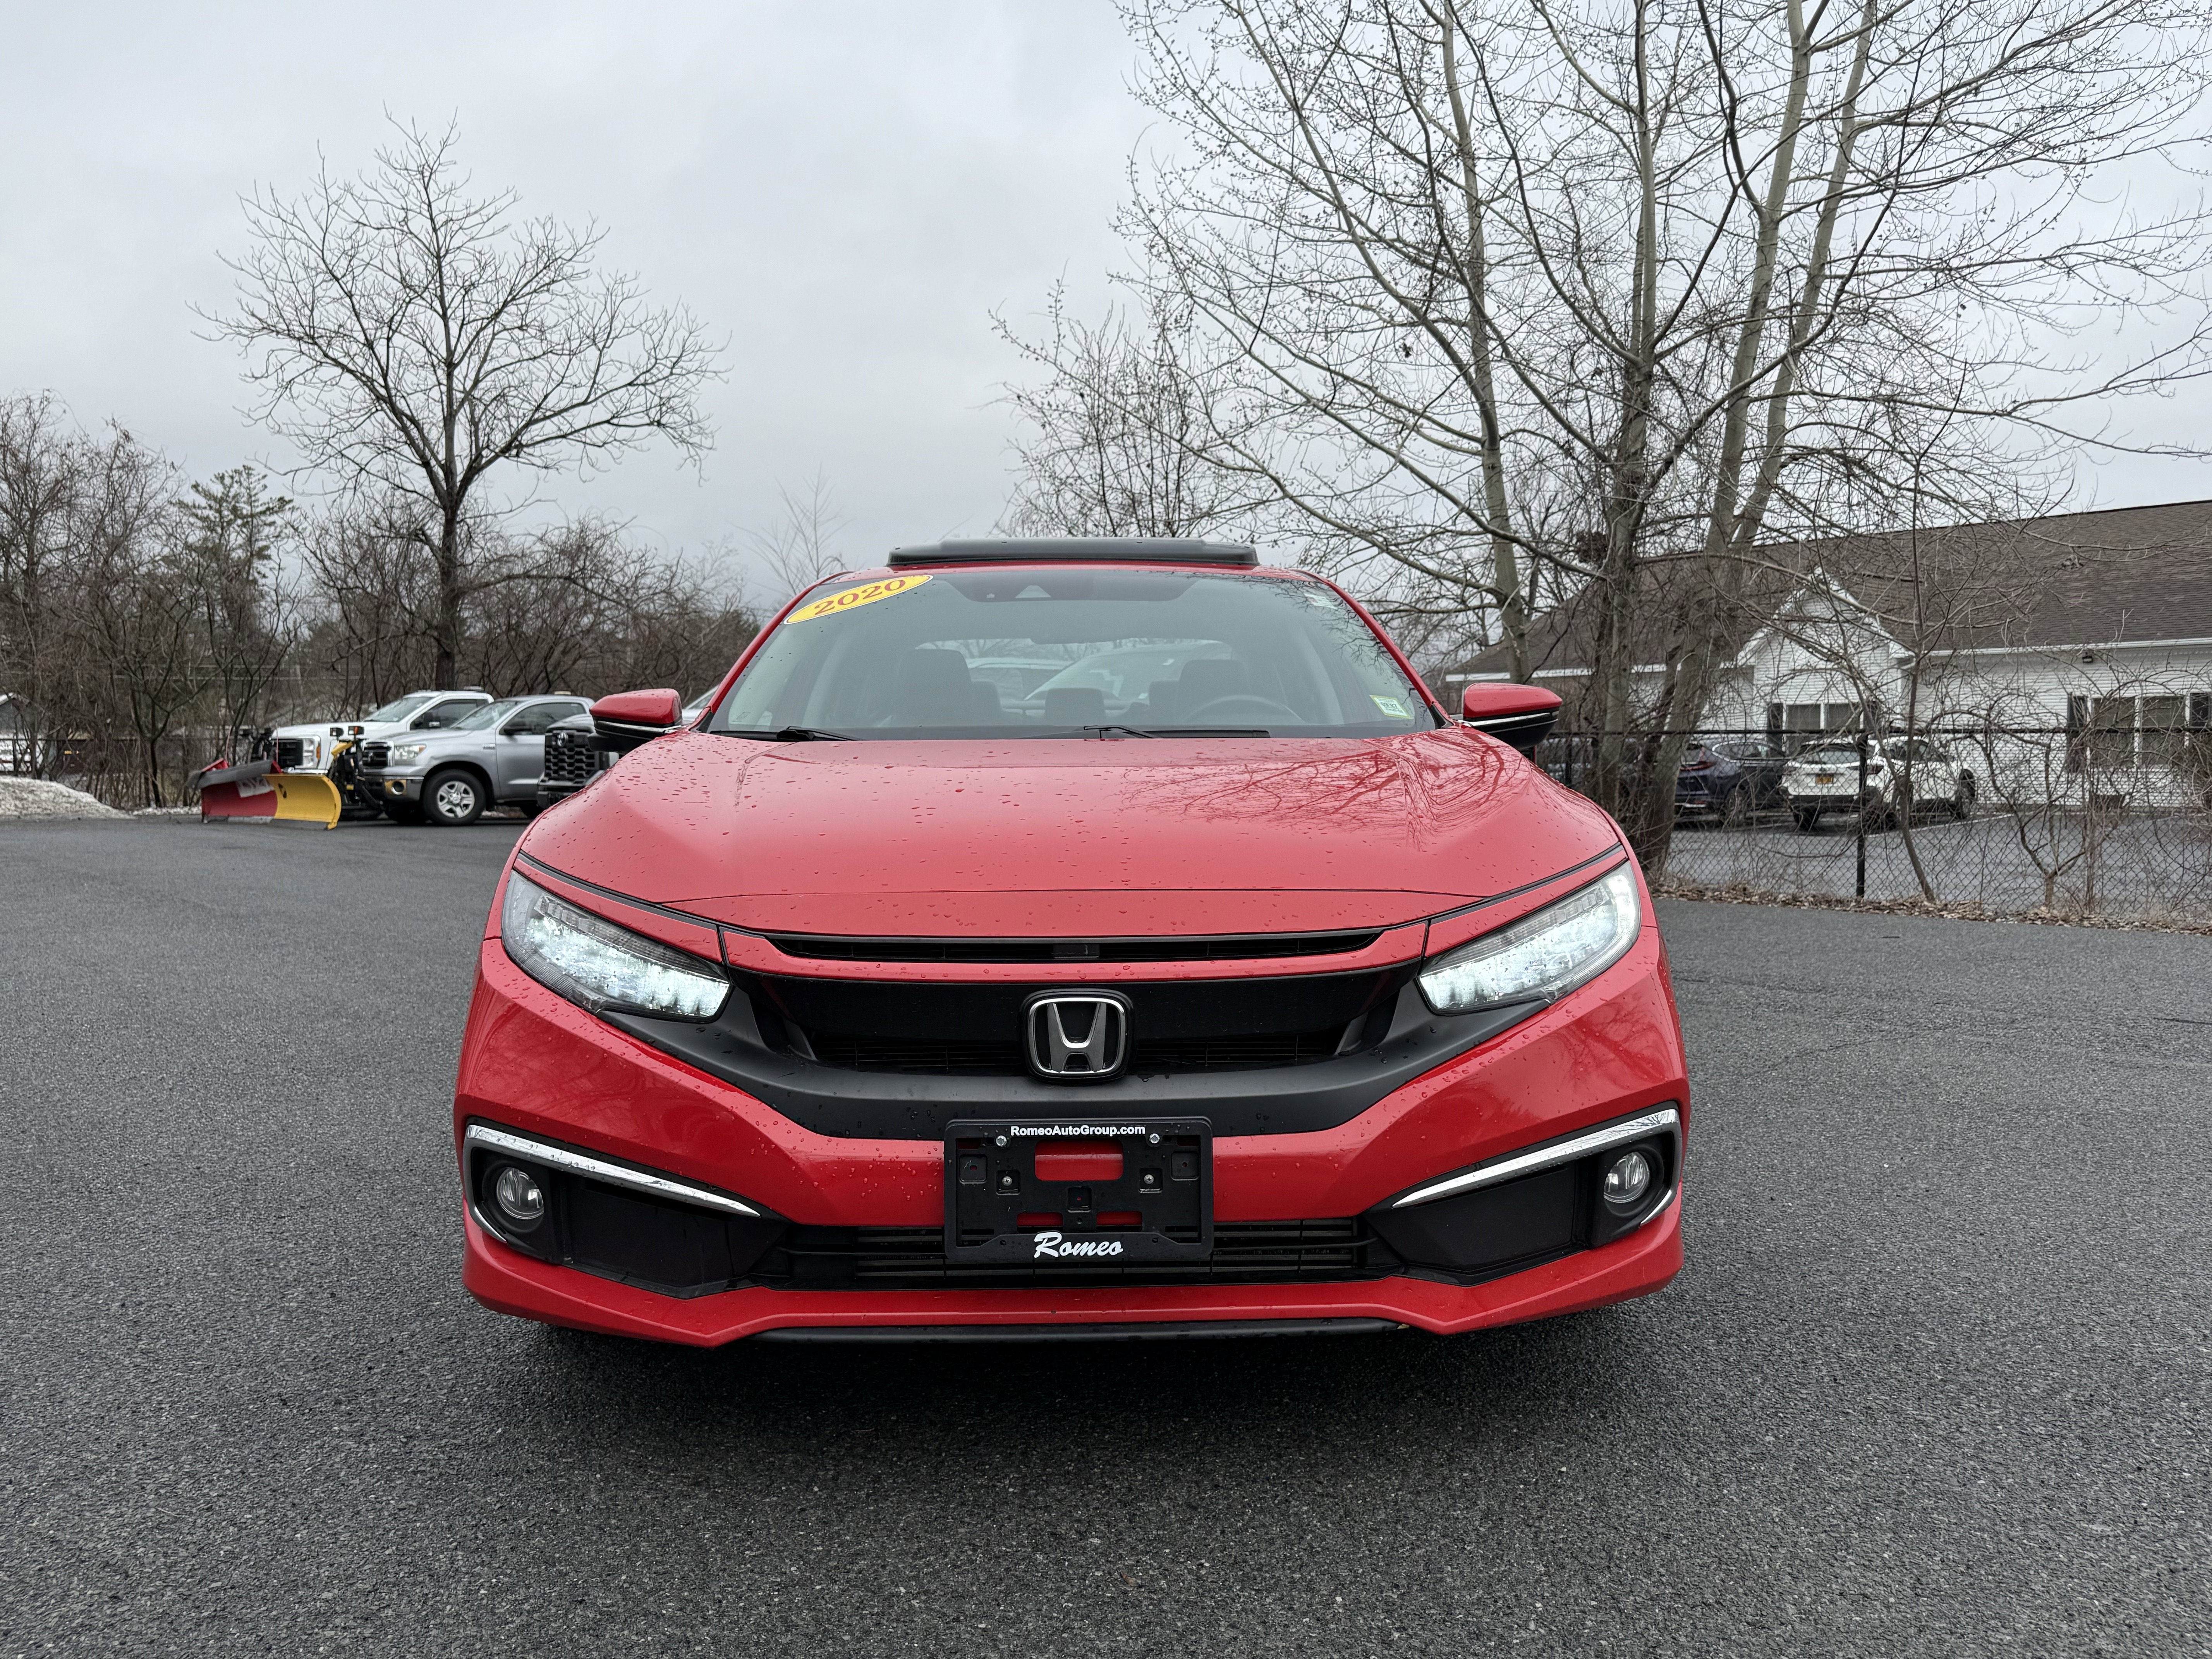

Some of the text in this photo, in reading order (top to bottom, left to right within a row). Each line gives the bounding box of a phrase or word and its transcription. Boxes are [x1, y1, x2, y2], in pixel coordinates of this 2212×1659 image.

[814, 580, 906, 615] 2020
[1010, 1124, 1146, 1137] RomeoAutoGroup.com
[1034, 1231, 1124, 1258] Romeo
